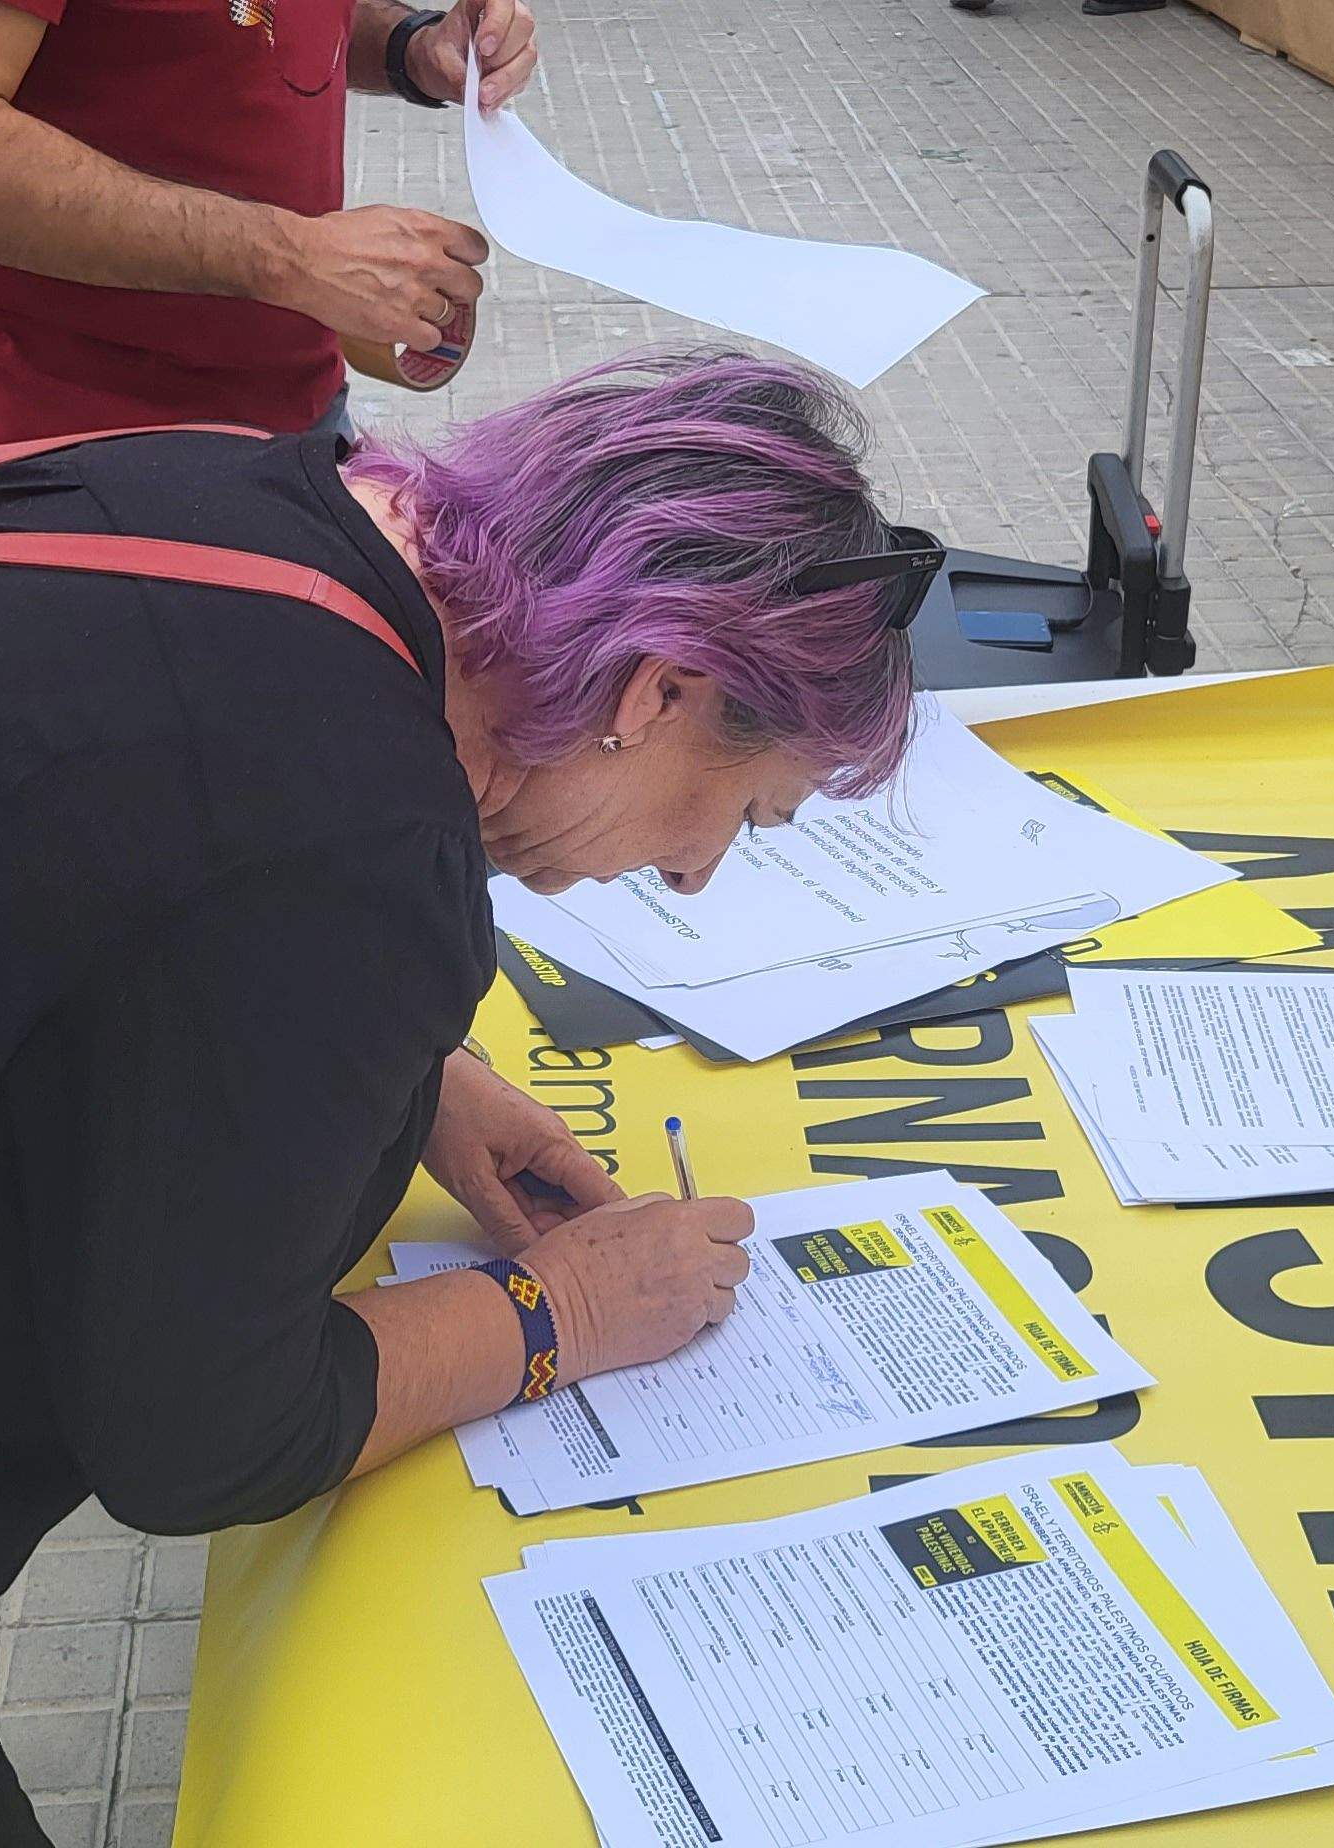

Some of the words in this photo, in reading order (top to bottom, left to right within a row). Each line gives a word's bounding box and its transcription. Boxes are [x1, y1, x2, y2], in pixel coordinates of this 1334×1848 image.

[791, 822, 845, 860] homicidios
[834, 815, 894, 857] desposesión
[890, 856, 908, 867] de
[903, 866, 938, 889] tierras
[853, 810, 924, 861] Discriminación,
[761, 847, 804, 878] funciona
[815, 889, 867, 923] apartheid
[870, 862, 919, 898] represión,
[850, 1228, 863, 1236] EL
[867, 1231, 897, 1259] DERRIBEN
[802, 1240, 835, 1273] PALESTINAS
[813, 1234, 829, 1245] LAS
[821, 1245, 851, 1274] VIVIENDAS
[894, 1213, 918, 1236] ISRAEL
[918, 1241, 959, 1287] TERRITORIOS
[953, 1288, 994, 1330] PALESTINOS
[989, 1331, 1028, 1370] OCUPADOS
[1023, 1322, 1048, 1341] HOJA
[1039, 1340, 1058, 1351] DE
[1048, 1350, 1082, 1376] FIRMAS
[971, 1507, 986, 1519] EL
[1021, 1484, 1050, 1520] ISRAEL
[1071, 1481, 1105, 1515] AMNISTÍA
[978, 1519, 1017, 1563] APARTHEID
[991, 1510, 1027, 1552] DERRIBEN
[1046, 1518, 1058, 1526] Y
[916, 1526, 956, 1573] PALESTINAS
[928, 1517, 947, 1534] LAS
[939, 1532, 975, 1575] VIVIENDAS
[1051, 1528, 1104, 1592] TERRITORIOS
[1021, 1506, 1053, 1545] DERRIBEN
[1048, 1546, 1059, 1557] EL
[1089, 1602, 1103, 1614] NO
[1098, 1614, 1116, 1630] LAS
[1111, 1631, 1148, 1673] VIVIENDAS
[1143, 1674, 1186, 1723] PALESTINAS
[1098, 1593, 1150, 1652] PALESTINOS
[1144, 1654, 1195, 1710] OCUPADOS
[1184, 1640, 1215, 1666] HOJA
[1204, 1666, 1229, 1682] DE
[1217, 1682, 1260, 1721] FIRMAS
